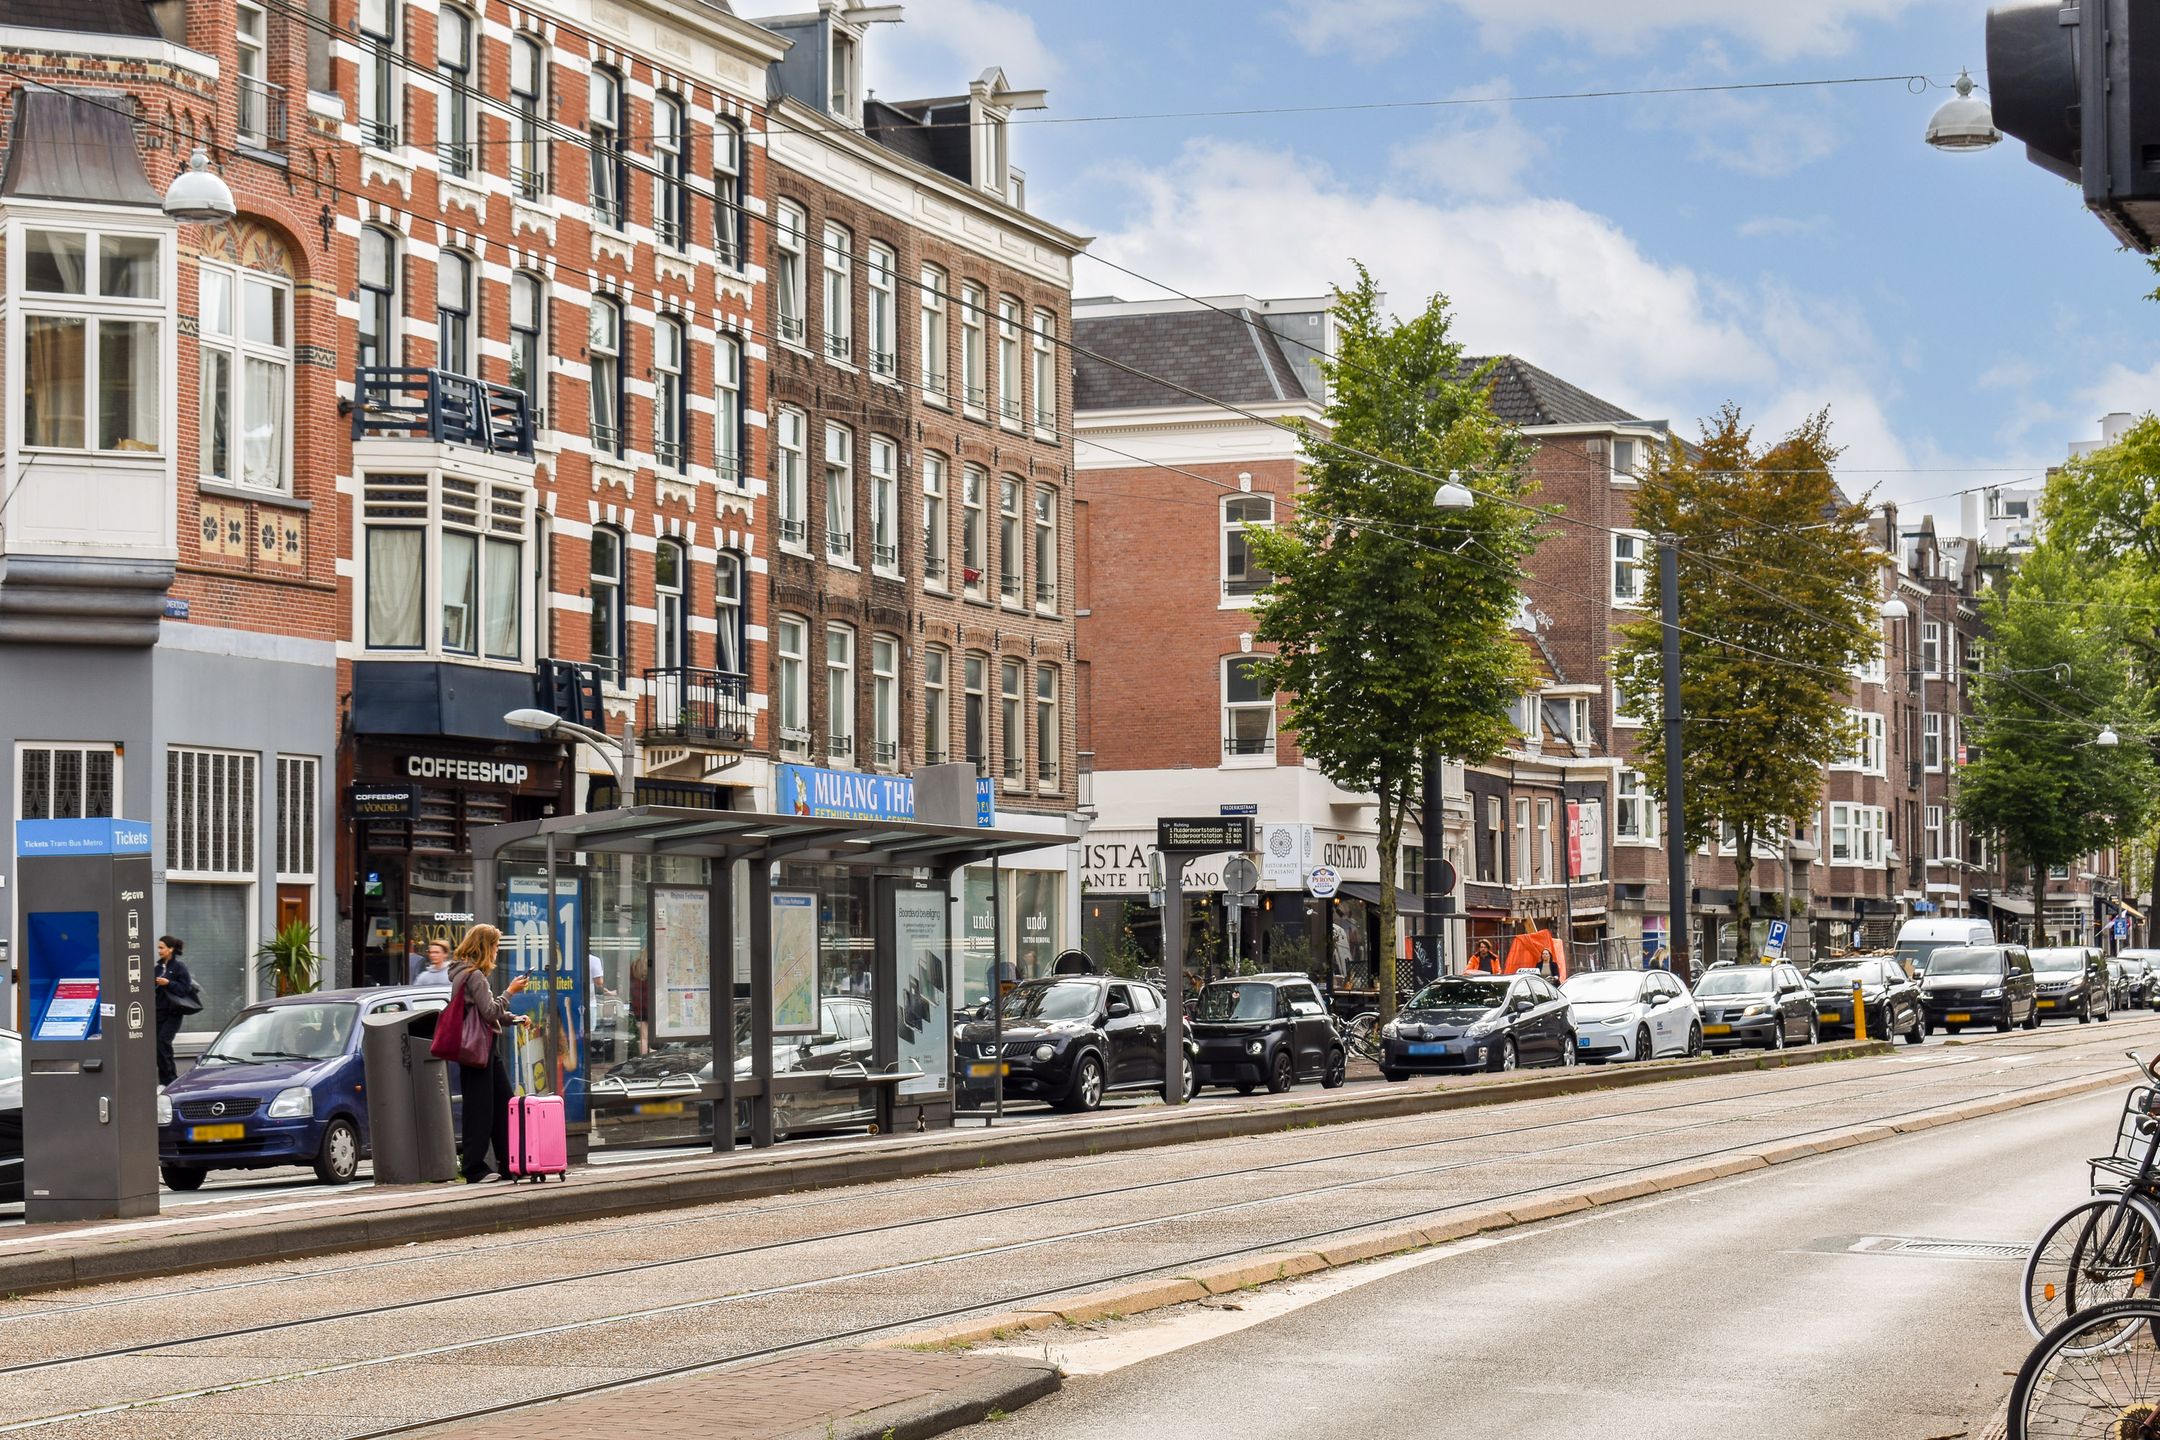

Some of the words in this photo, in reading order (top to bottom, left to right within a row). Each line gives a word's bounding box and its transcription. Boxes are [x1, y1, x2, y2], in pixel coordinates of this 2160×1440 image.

[408, 755, 528, 785] COFFEESHOP
[355, 793, 409, 801] COFFEESHOP
[815, 772, 878, 811] MUANG
[363, 803, 400, 813] VONDEL
[24, 840, 48, 848] Tickets
[69, 839, 82, 847] Bus
[83, 839, 103, 847] Metro
[114, 831, 148, 845] Tickets
[1324, 843, 1367, 869] GUSTATIO
[132, 891, 144, 899] GVB
[513, 901, 529, 916] Lidl
[530, 901, 538, 916] is
[1026, 911, 1047, 930] undo
[1773, 923, 1784, 937] P
[127, 941, 140, 949] Tram
[130, 984, 139, 993] Bus
[128, 1031, 143, 1039] Metro
